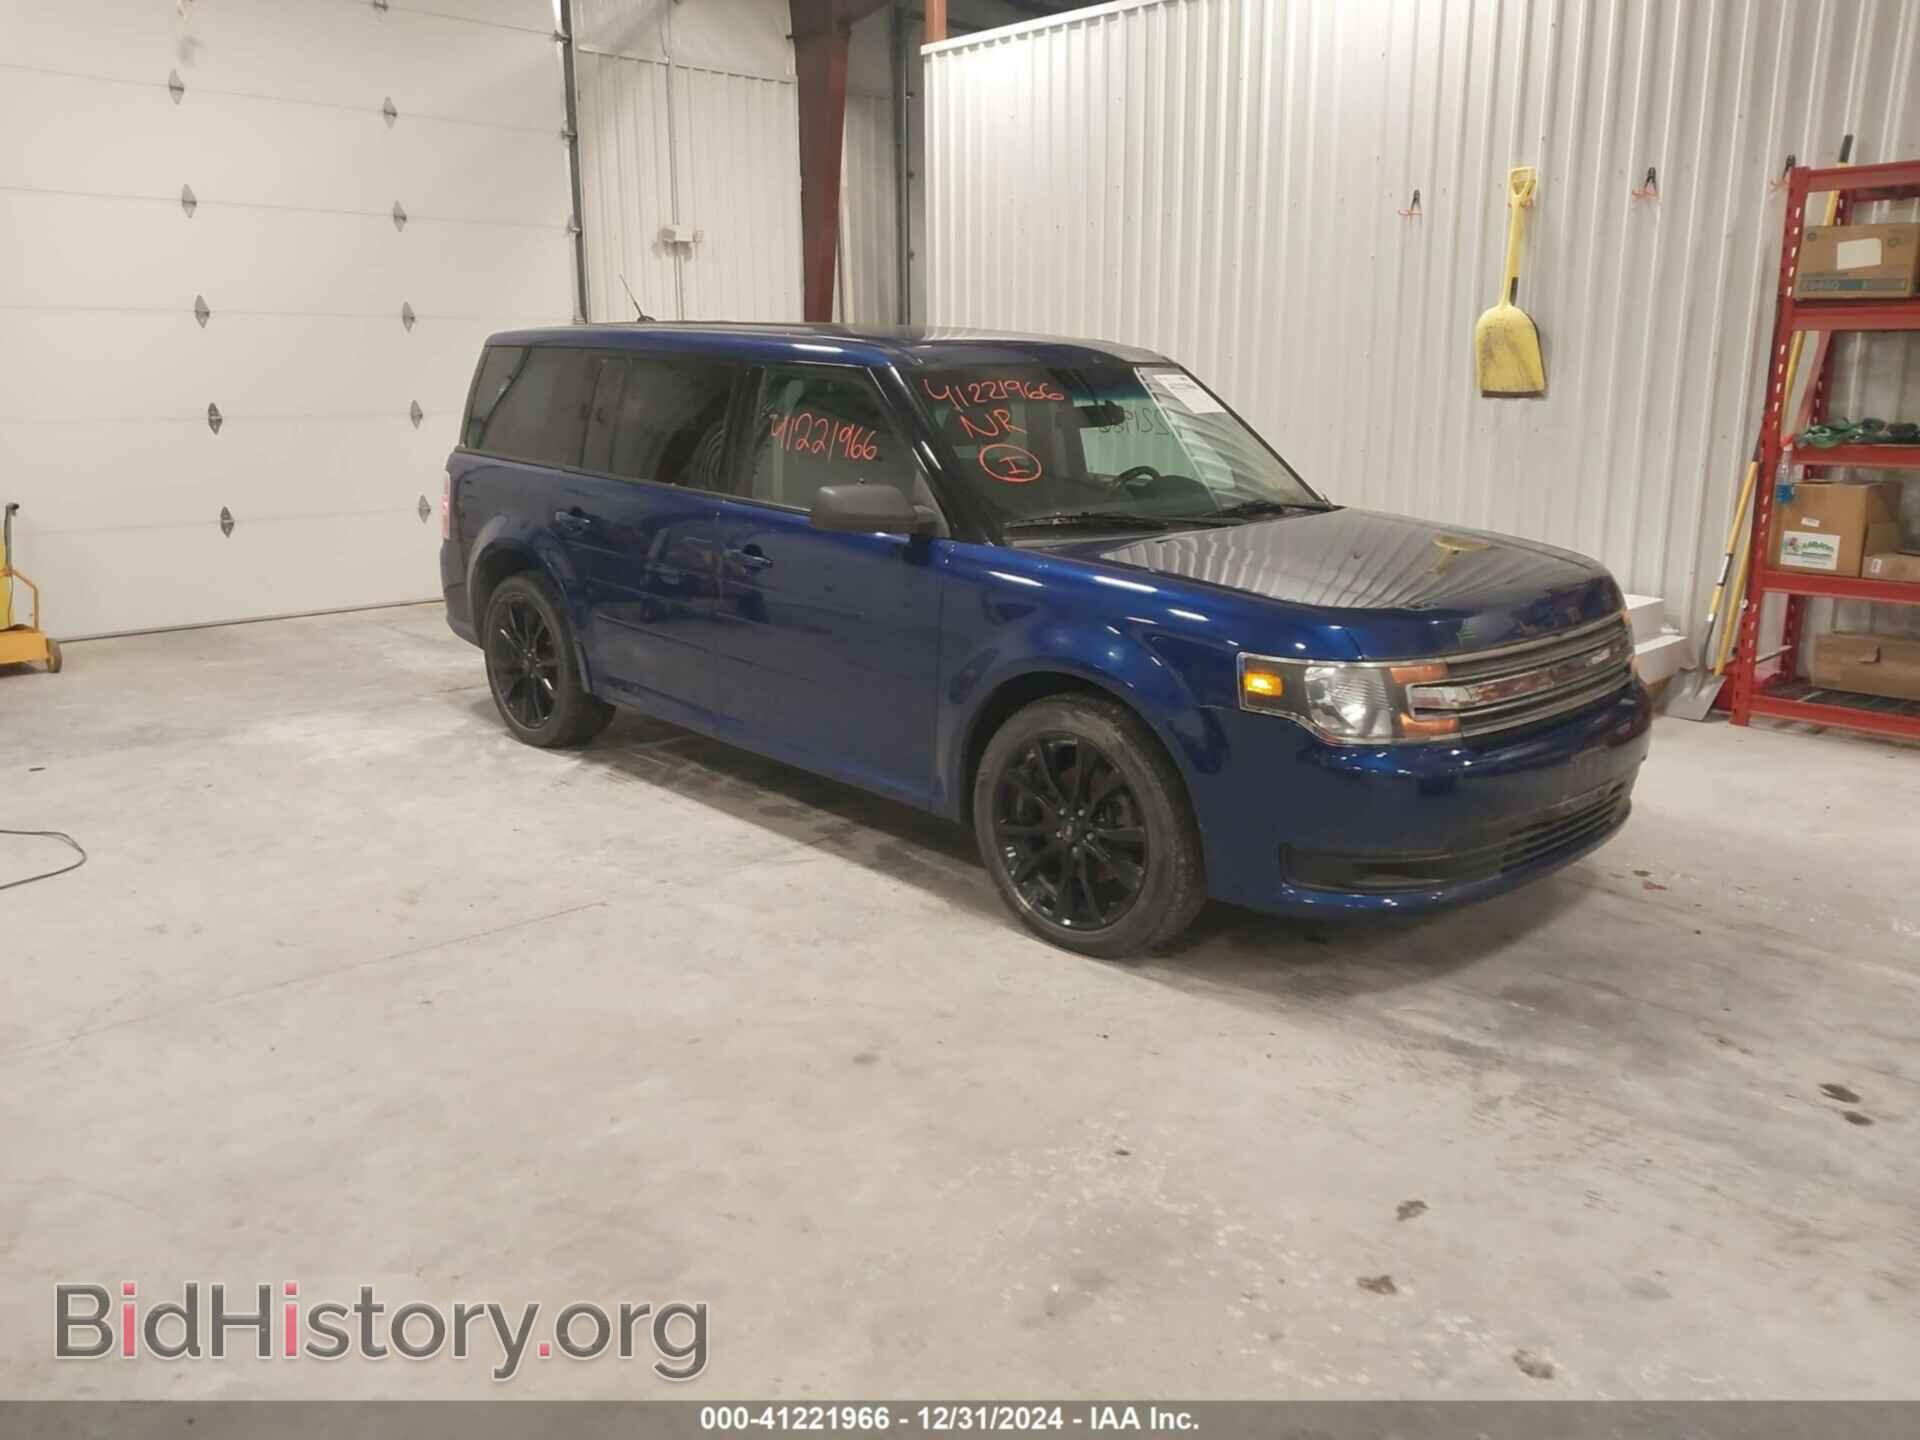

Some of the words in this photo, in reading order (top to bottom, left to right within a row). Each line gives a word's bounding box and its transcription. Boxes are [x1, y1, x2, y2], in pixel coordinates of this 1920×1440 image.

[923, 378, 1065, 412] 41221966
[769, 412, 878, 462] 41221966
[960, 409, 1027, 439] NR
